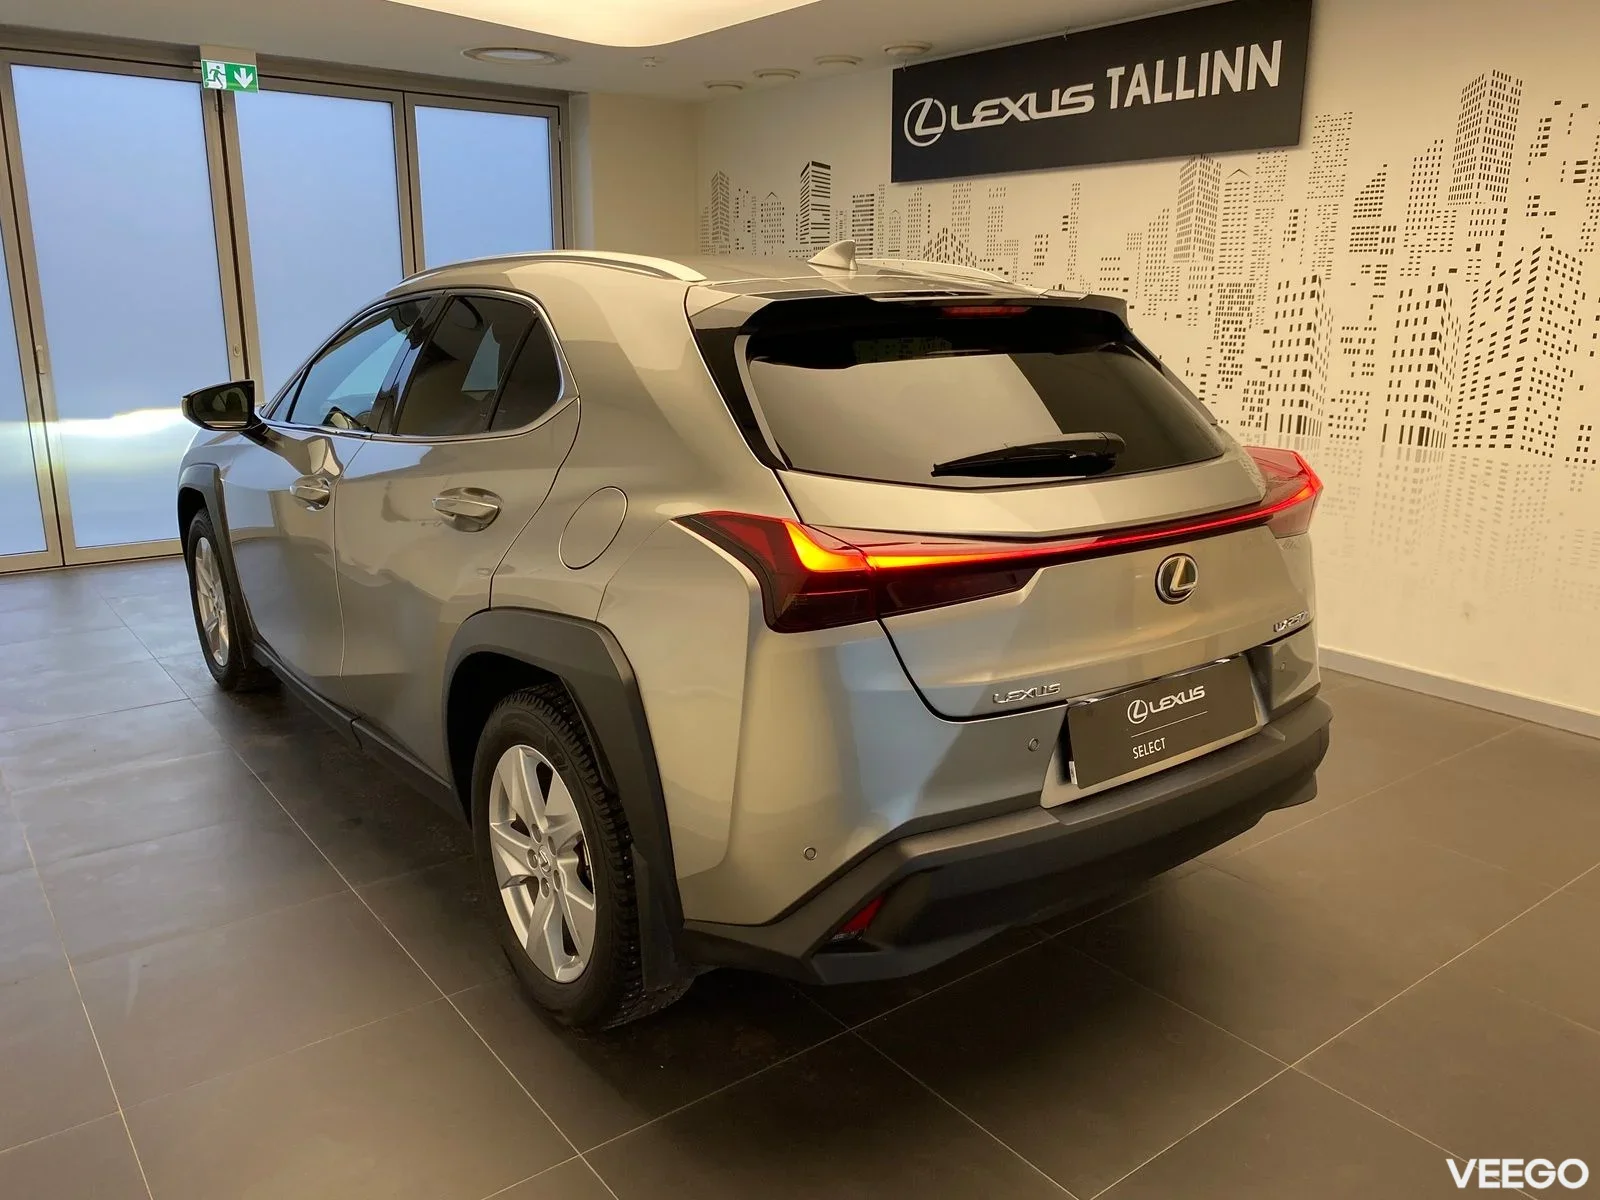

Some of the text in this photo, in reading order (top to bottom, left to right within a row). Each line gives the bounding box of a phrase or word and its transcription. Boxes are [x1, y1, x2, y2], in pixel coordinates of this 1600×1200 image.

[951, 83, 1095, 131] LEXUS
[1107, 39, 1282, 110] TALLINN
[992, 682, 1061, 704] LEXUS
[1149, 685, 1206, 713] LEXUS
[1132, 737, 1166, 760] SELECT
